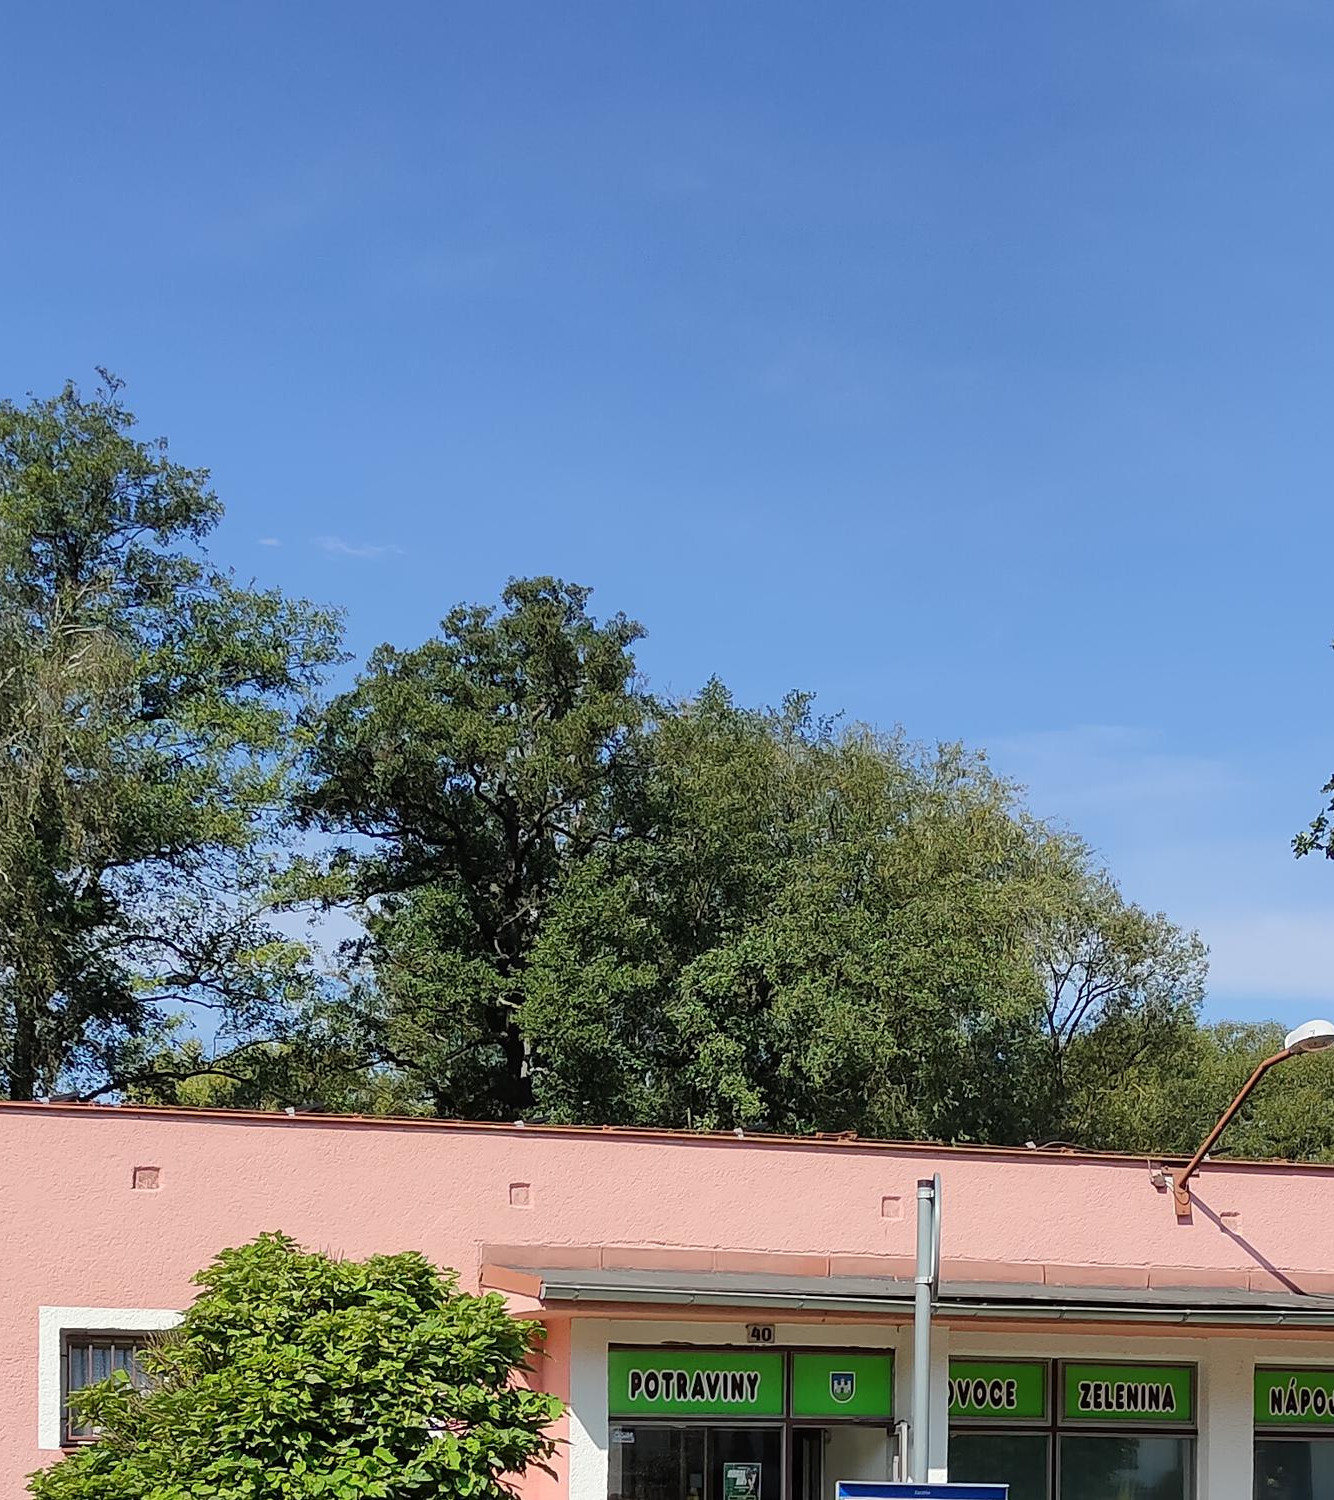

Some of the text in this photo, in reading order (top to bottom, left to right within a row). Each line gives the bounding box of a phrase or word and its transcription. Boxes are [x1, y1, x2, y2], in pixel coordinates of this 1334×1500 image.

[751, 1326, 772, 1342] 40
[629, 1369, 760, 1403] POTRAVINY
[1078, 1381, 1177, 1413] ZELENINA
